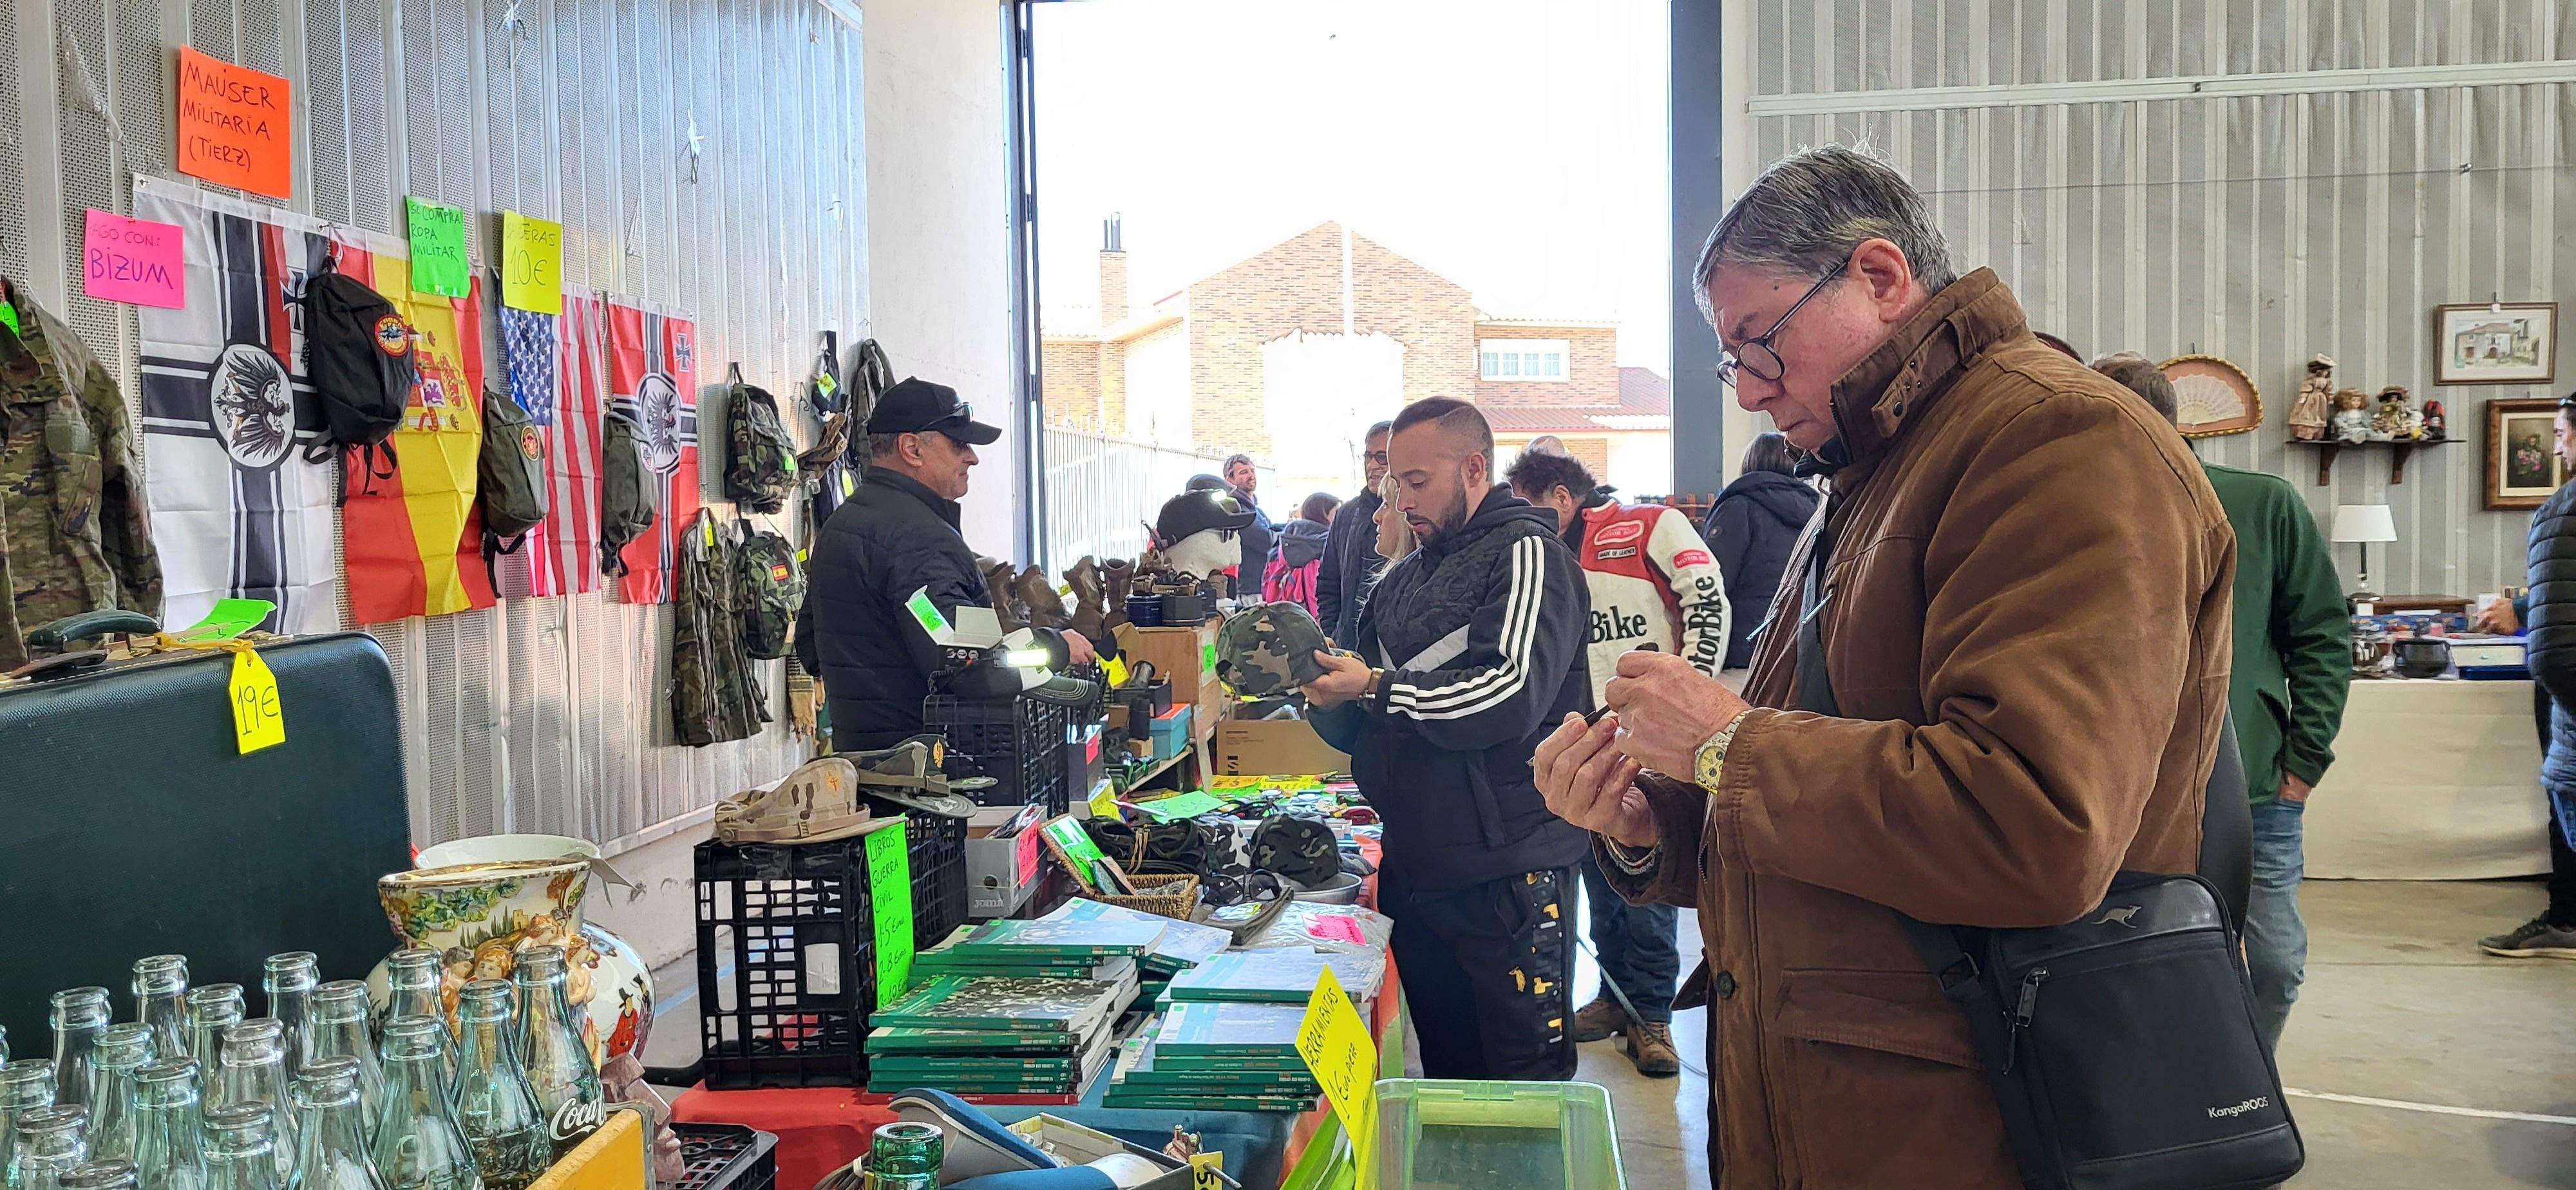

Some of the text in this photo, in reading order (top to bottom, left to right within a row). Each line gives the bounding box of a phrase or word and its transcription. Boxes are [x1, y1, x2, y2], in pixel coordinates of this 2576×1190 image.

[184, 61, 276, 110] MAUSER
[422, 205, 461, 224] COMPRA
[410, 223, 439, 241] ROPA
[510, 247, 548, 286] 10€
[237, 685, 279, 736] 19€
[871, 858, 899, 889] GUERRA
[1060, 1072, 1067, 1081] 19
[2206, 1096, 2269, 1119] KangaROOS
